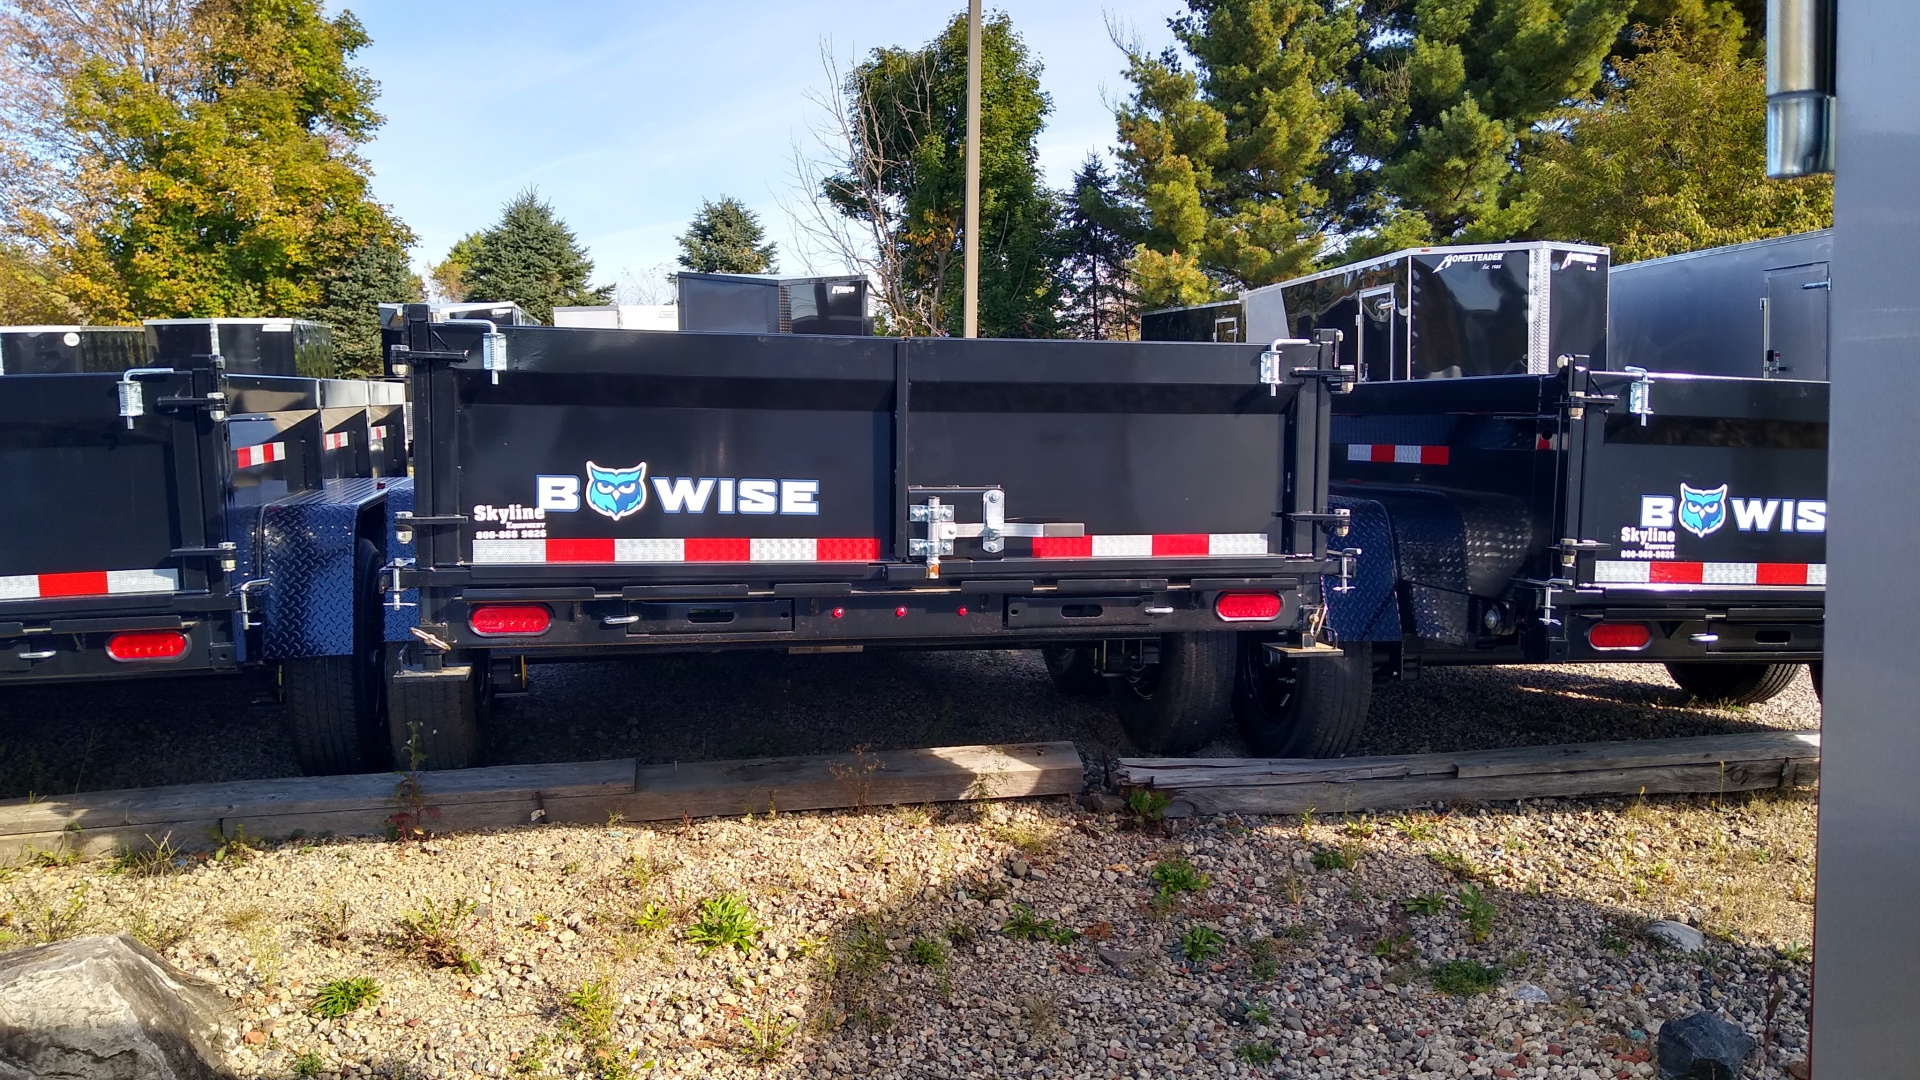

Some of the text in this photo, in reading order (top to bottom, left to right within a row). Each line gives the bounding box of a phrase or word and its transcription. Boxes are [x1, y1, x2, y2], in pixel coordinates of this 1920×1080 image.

[1432, 253, 1503, 273] HOMESTEADER
[536, 475, 819, 515] B WISE
[473, 504, 546, 524] Skyline
[1641, 495, 1675, 529] B
[1620, 526, 1676, 546] Skyline
